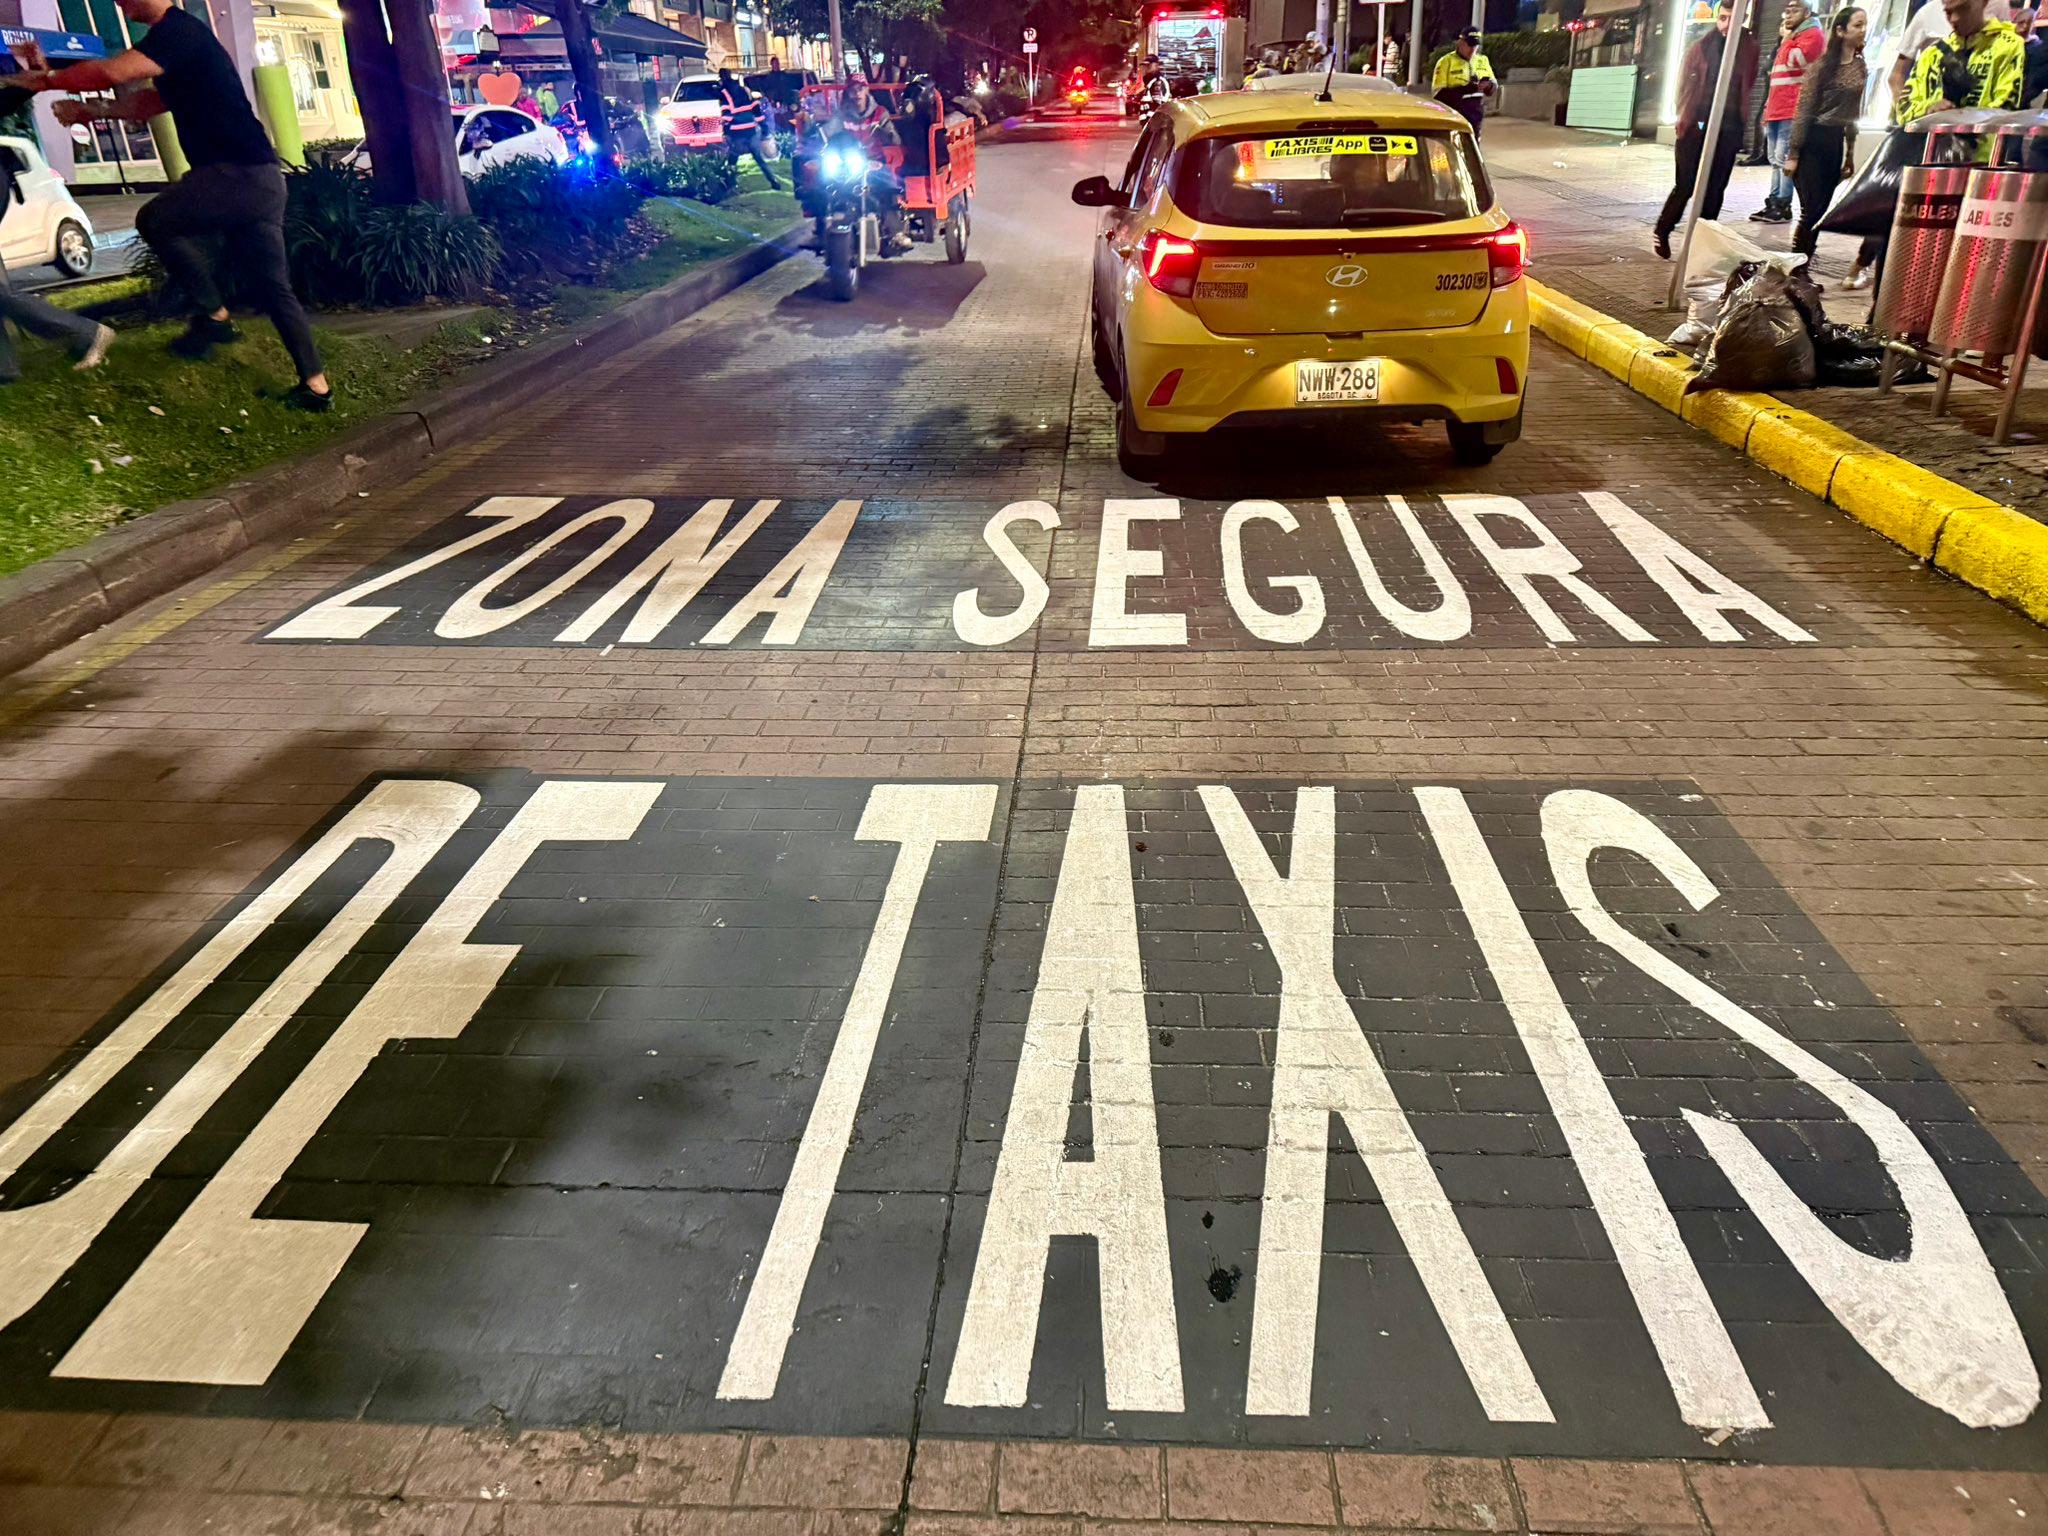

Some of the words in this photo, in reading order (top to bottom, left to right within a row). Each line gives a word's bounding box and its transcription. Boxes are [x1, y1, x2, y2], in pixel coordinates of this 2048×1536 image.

[1273, 137, 1318, 148] TAXIS
[1336, 139, 1363, 150] App
[1285, 146, 1333, 155] LIBRES
[1435, 273, 1473, 291] 30230
[264, 497, 863, 646] ZONA
[952, 491, 1818, 647] SEGURA
[0, 780, 666, 1386] DE
[716, 783, 2041, 1429] TAXIS
